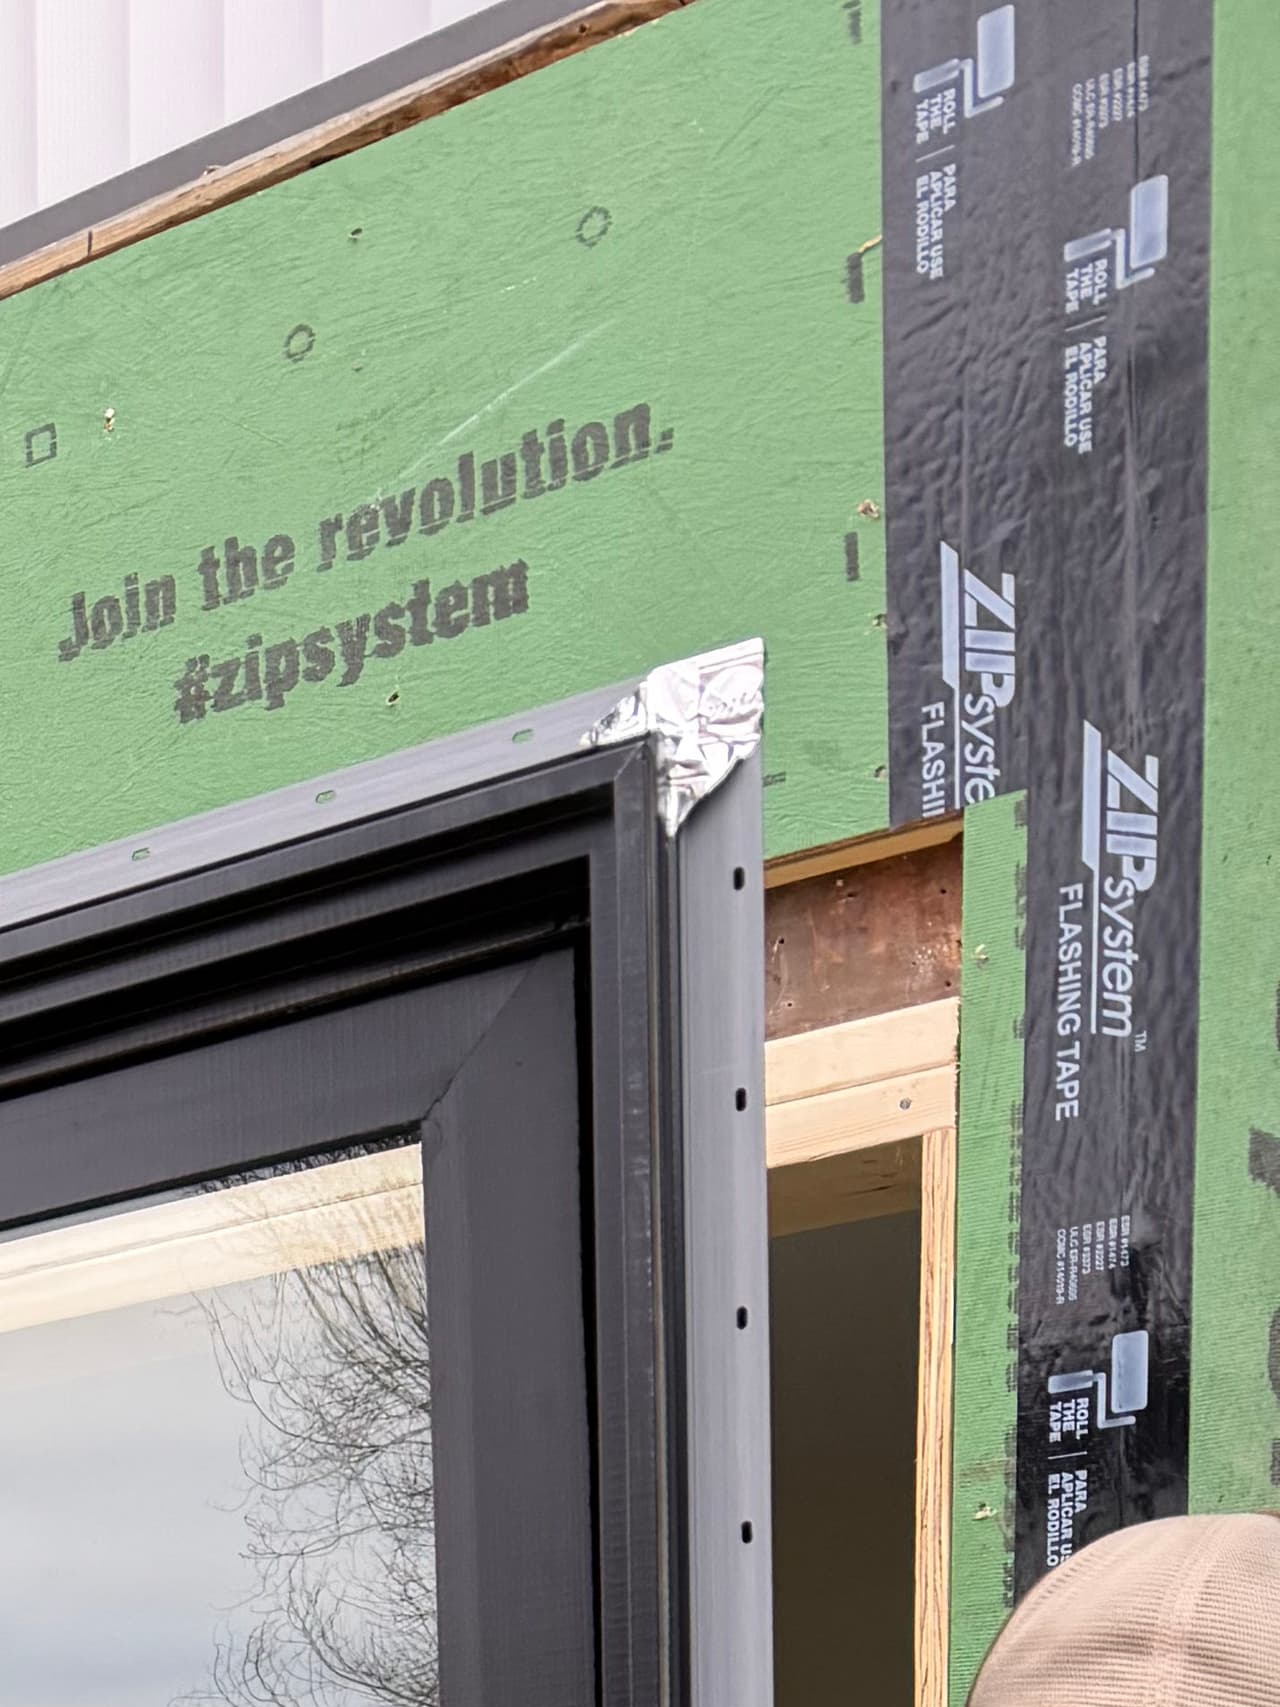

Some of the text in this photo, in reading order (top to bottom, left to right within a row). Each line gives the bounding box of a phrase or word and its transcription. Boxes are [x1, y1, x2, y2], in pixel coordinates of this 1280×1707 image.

[57, 402, 675, 663] Join the revolution.
[174, 557, 531, 724] #zipsystem
[1054, 883, 1083, 1121] FLASHING TAPE
